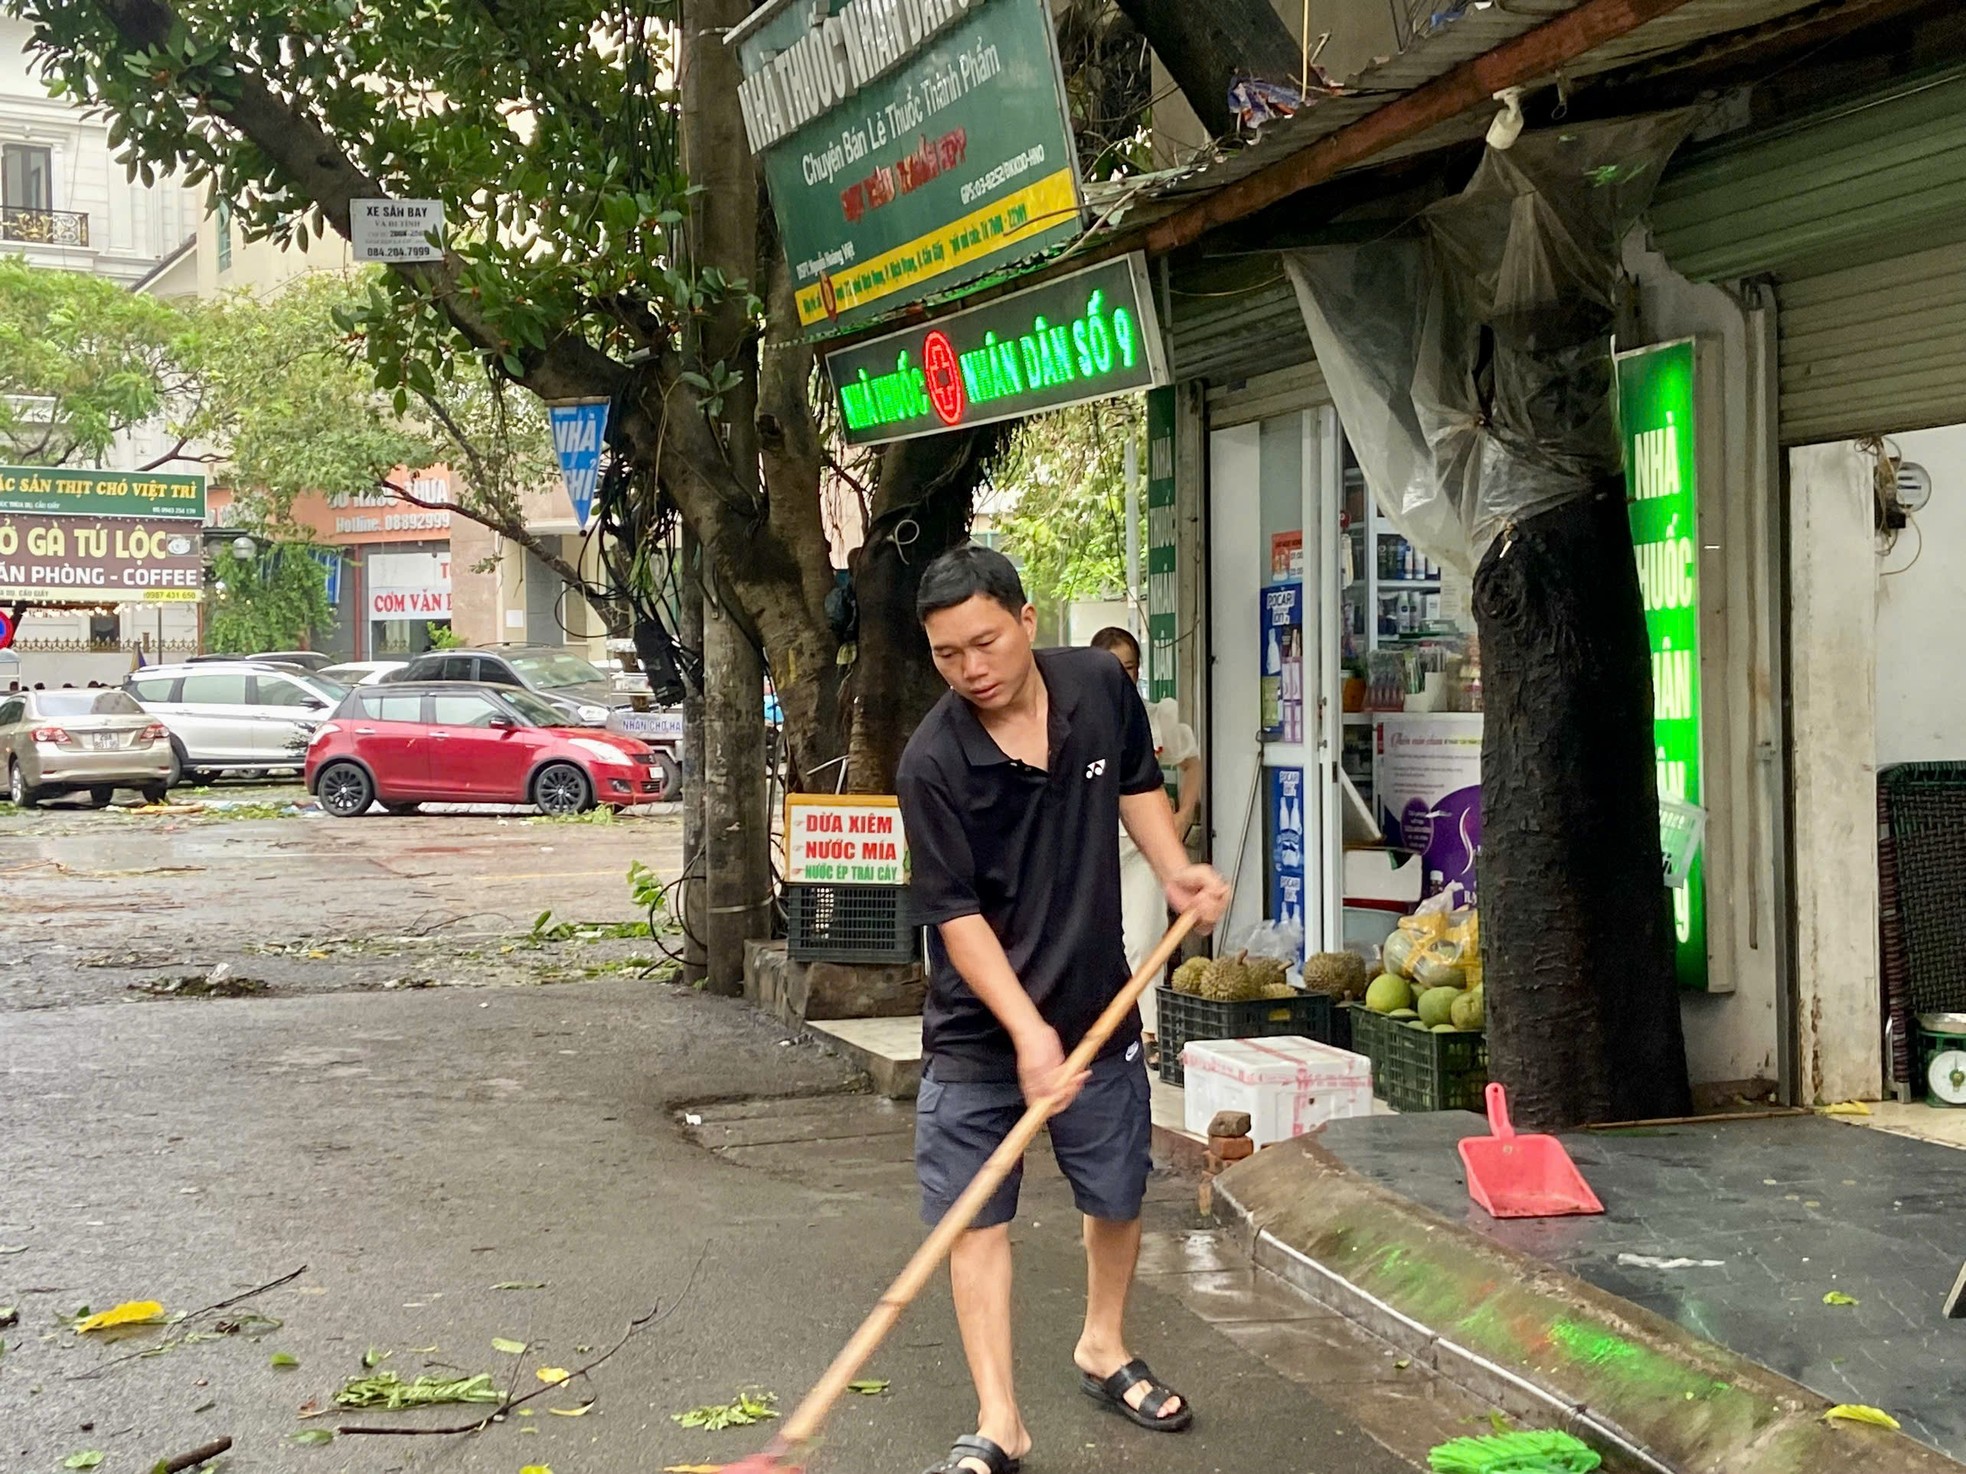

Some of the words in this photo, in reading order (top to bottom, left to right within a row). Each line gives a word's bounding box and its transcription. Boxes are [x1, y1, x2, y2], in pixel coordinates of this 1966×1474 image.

[737, 52, 785, 155] NHÀ
[774, 1, 846, 129] THUỐC
[803, 141, 845, 186] Chuyên
[842, 126, 869, 163] Bán
[867, 112, 887, 150] Lẻ
[885, 84, 923, 139] Thuốc
[920, 64, 961, 116] Thành
[959, 36, 1000, 93] Phẩm
[366, 206, 379, 217] XE
[383, 204, 404, 217] SÂN
[408, 207, 428, 217] BAY
[960, 331, 1022, 403] NHÂN
[1019, 315, 1075, 390] DÂN
[1073, 289, 1112, 377] SỐ
[1114, 308, 1135, 367] 9
[1635, 411, 1681, 500] NHÀ
[20, 473, 52, 493] SẢN
[55, 479, 93, 498] THỊT
[96, 478, 128, 496] CHÓ
[132, 480, 168, 501] VIỆT
[171, 481, 197, 499] TRÌ
[27, 520, 65, 556] GÀ
[74, 523, 108, 558] TỨ
[115, 524, 167, 566] LỘC
[31, 563, 105, 585] PHÒNG
[123, 568, 197, 586] COFFEE
[1633, 513, 1692, 611] HUỐC
[374, 591, 405, 613] CƠM
[410, 588, 442, 612] VĂN
[806, 811, 843, 833] DỪA
[848, 812, 892, 833] XIÊM
[805, 839, 856, 860] NƯỚC
[862, 840, 897, 860] MÍA
[805, 862, 833, 879] NƯỚC
[836, 863, 848, 880] ÉP
[851, 863, 875, 880] TRÁI
[877, 864, 898, 881] CÂY
